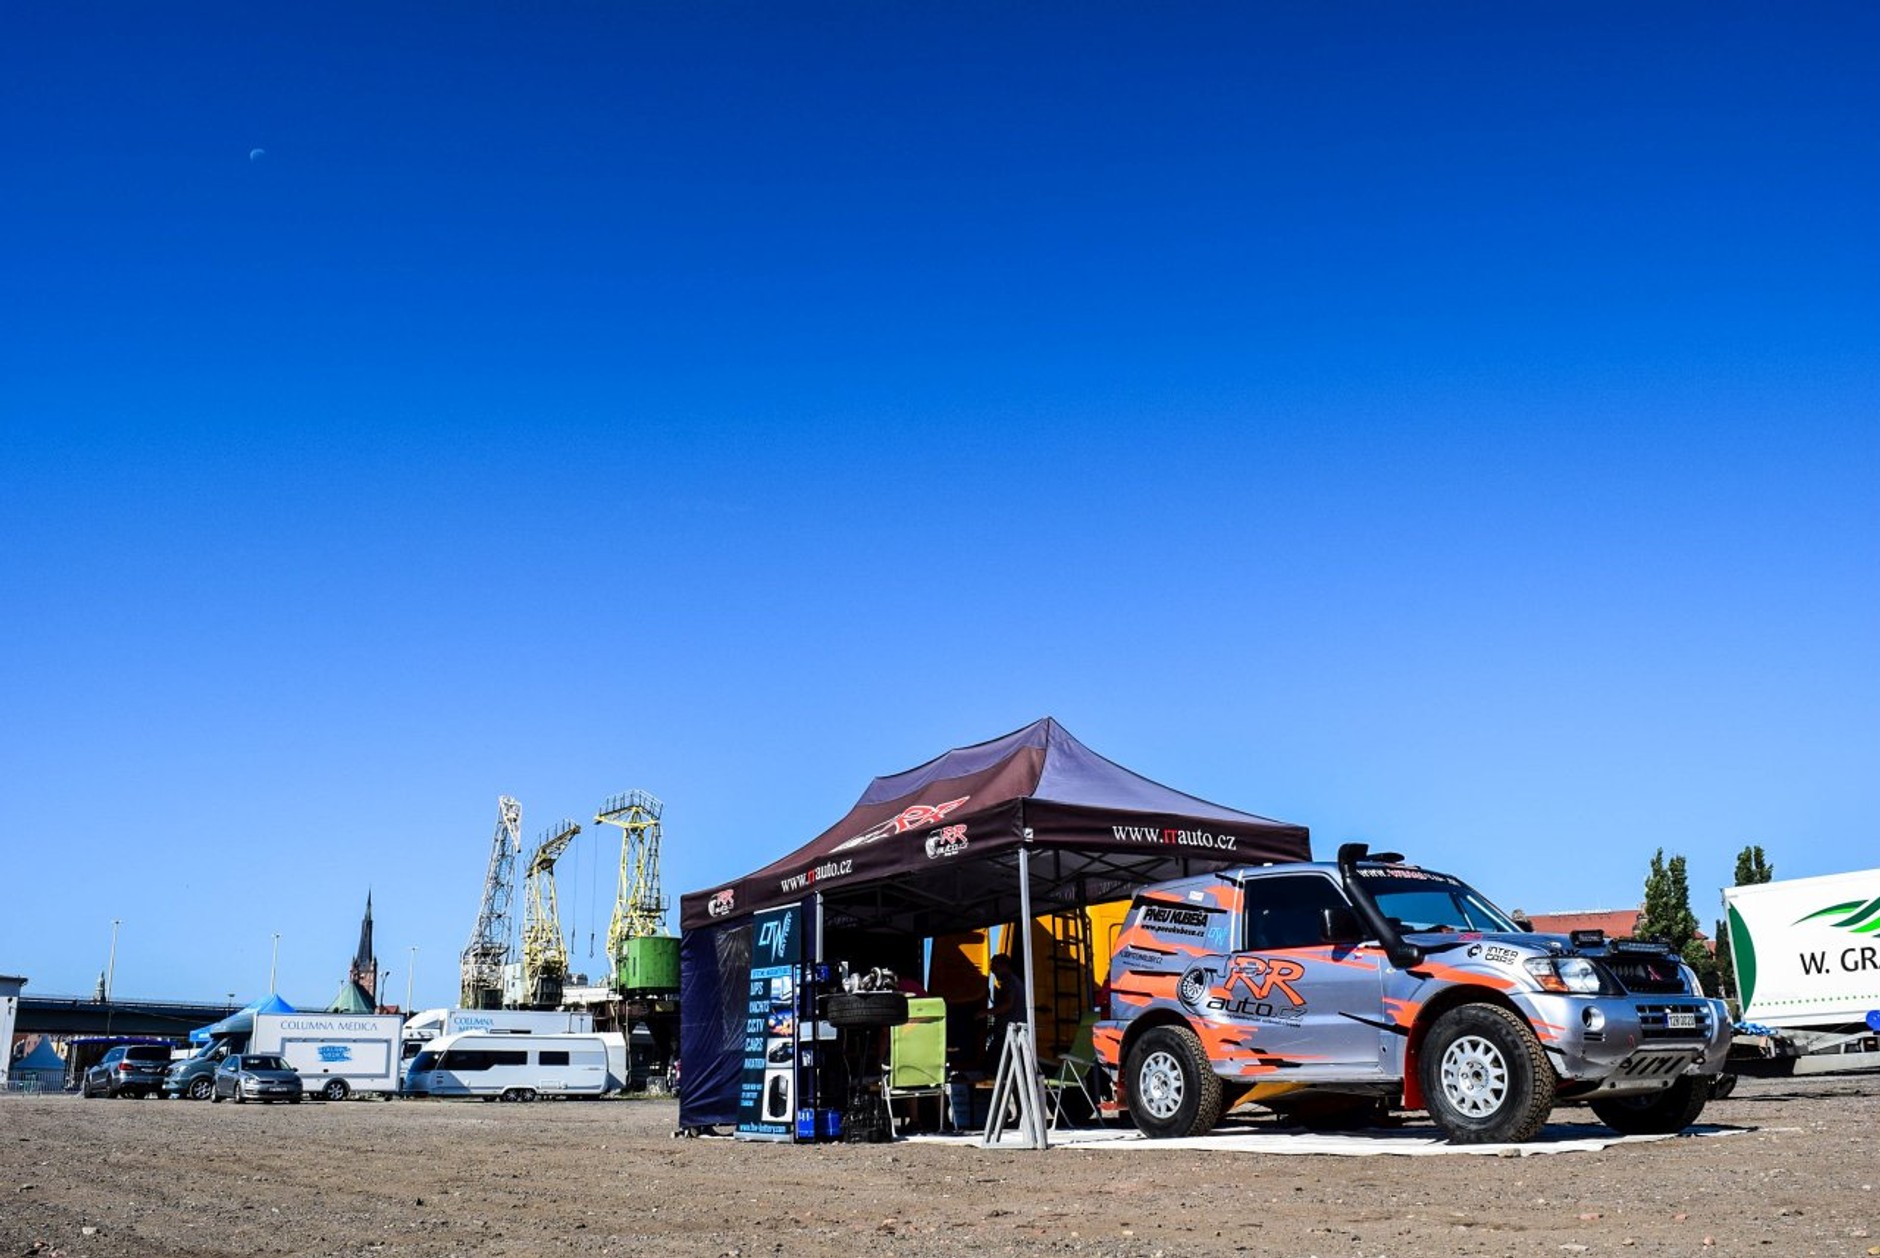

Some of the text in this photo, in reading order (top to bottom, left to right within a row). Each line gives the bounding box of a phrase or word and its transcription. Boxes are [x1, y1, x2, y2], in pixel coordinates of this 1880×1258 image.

[1112, 825, 1237, 851] www.rrauto.cz
[780, 858, 852, 893] www.rrauto.cz
[1143, 908, 1170, 923] PNEU
[1800, 951, 1830, 975] W.
[1224, 955, 1307, 1008] RR
[1205, 996, 1308, 1021] auto.cz
[280, 1020, 378, 1031] COLUMNA MEDICA
[454, 1017, 493, 1026] COLUMNA
[746, 1018, 765, 1033] CCTV
[744, 1037, 764, 1052] CARS
